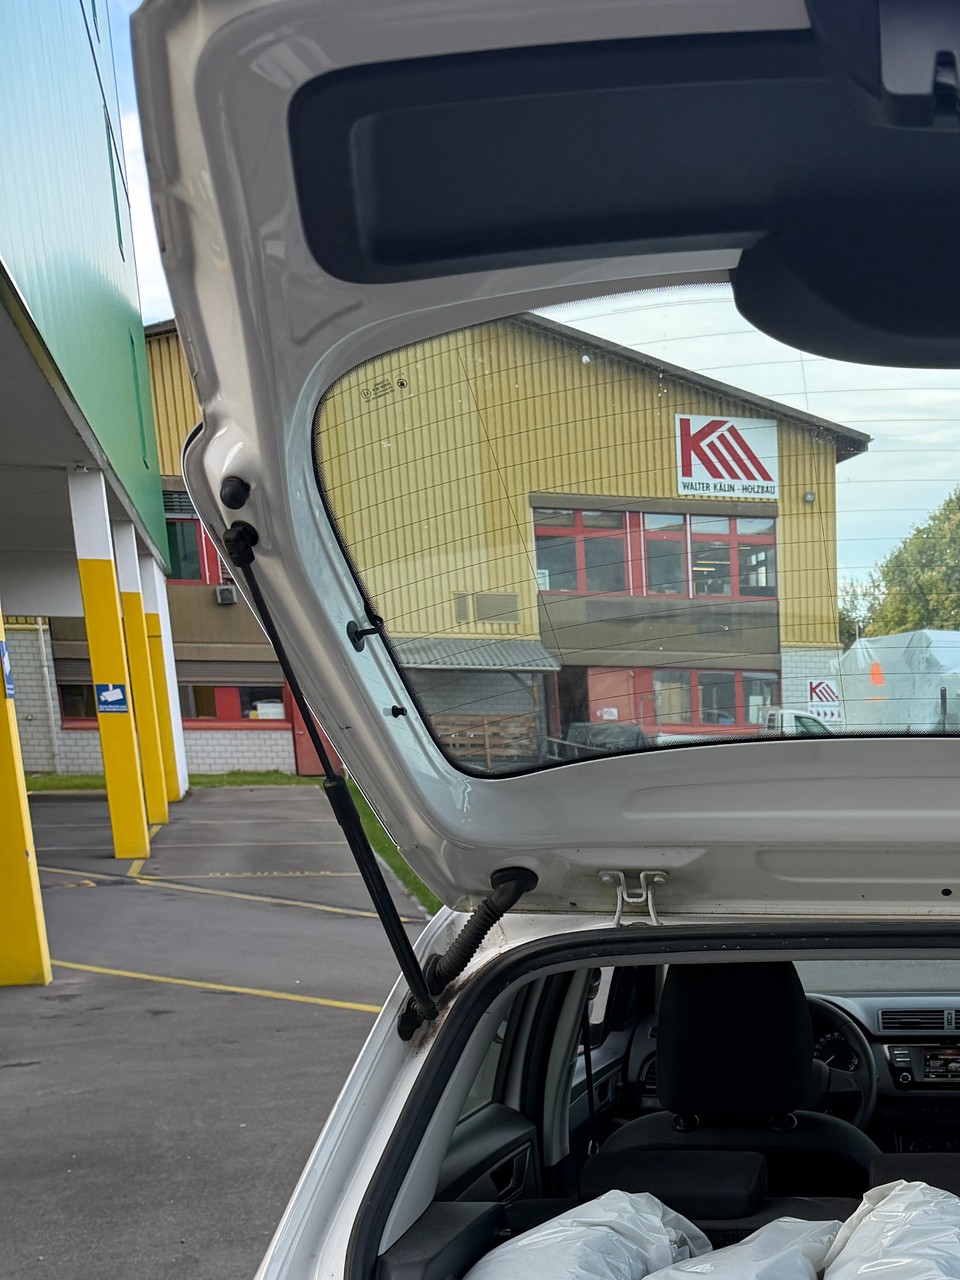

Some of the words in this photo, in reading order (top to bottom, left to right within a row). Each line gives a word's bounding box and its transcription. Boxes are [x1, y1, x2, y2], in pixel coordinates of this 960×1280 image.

[682, 482, 711, 492] WALTER
[714, 483, 735, 493] KÄLIN
[742, 484, 776, 495] HOLZBAU
